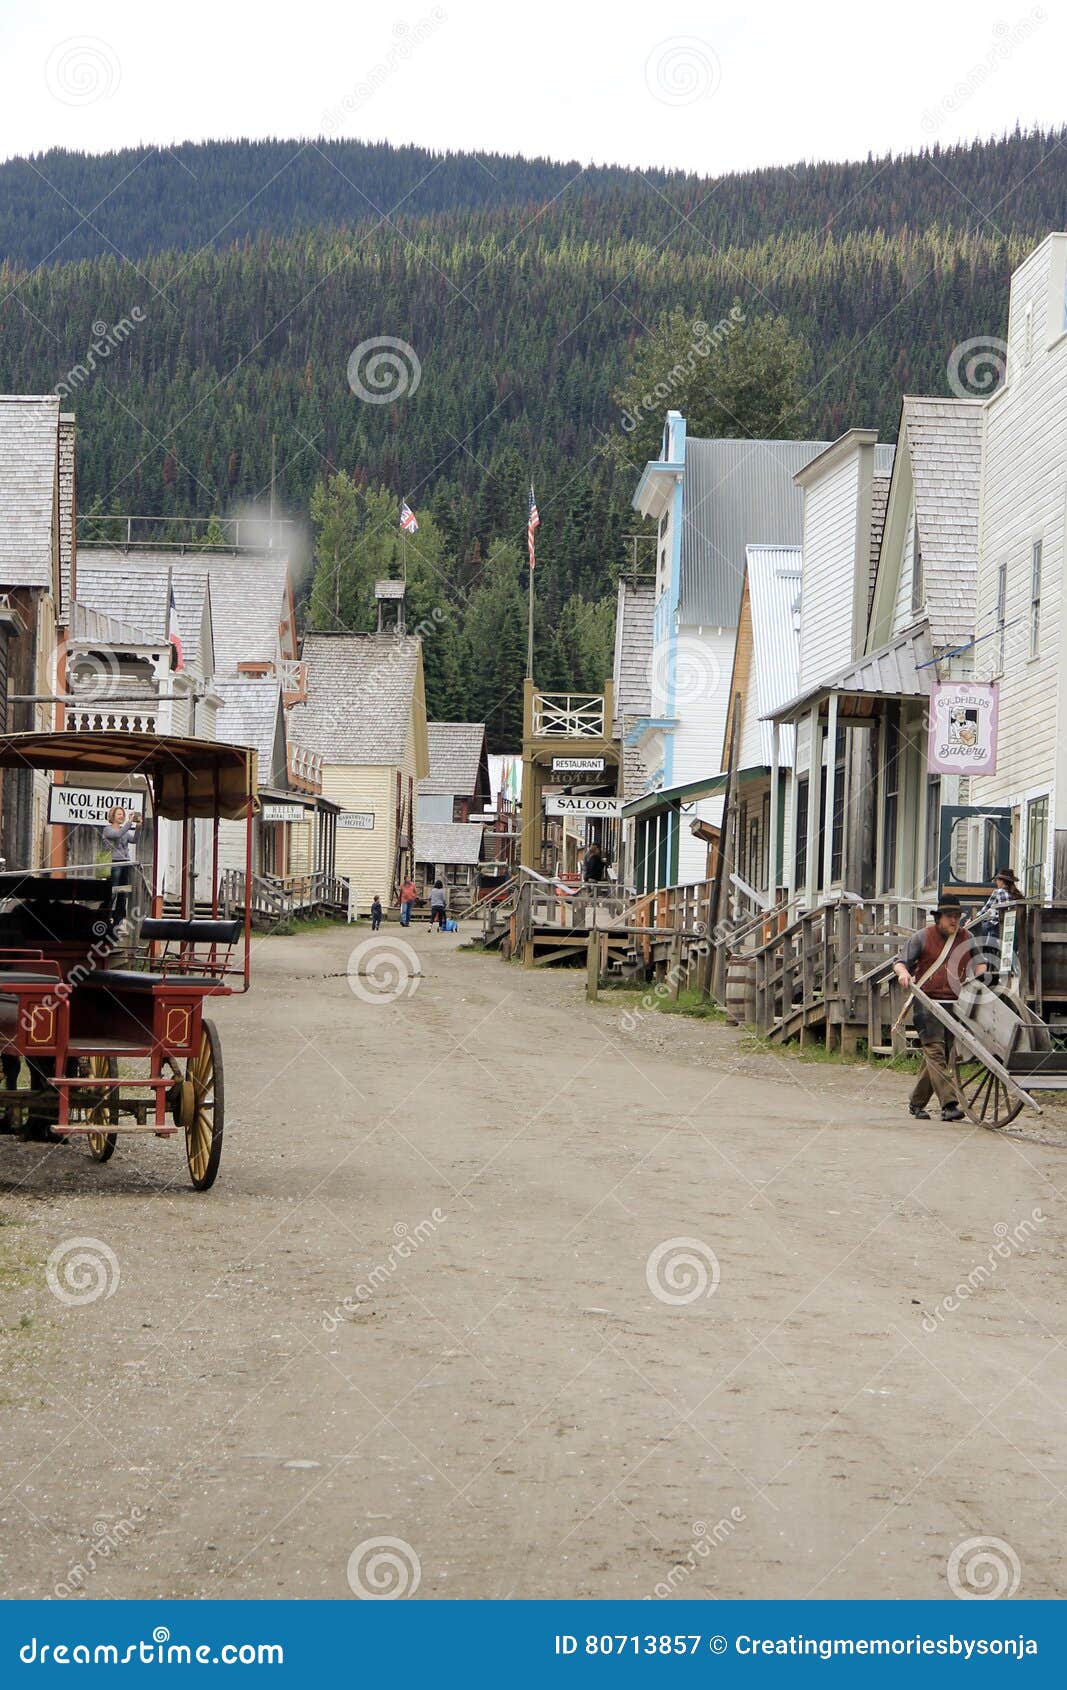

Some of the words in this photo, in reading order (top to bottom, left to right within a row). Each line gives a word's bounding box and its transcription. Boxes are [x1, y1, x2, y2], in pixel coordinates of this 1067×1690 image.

[937, 696, 990, 708] GOLDFIELDS
[939, 744, 987, 760] Bakery
[555, 760, 602, 768] RESTAURANT
[550, 774, 605, 783] HOTEL
[58, 792, 93, 807] NICOL
[96, 795, 135, 811] HOTEL
[557, 799, 617, 810] SALOON
